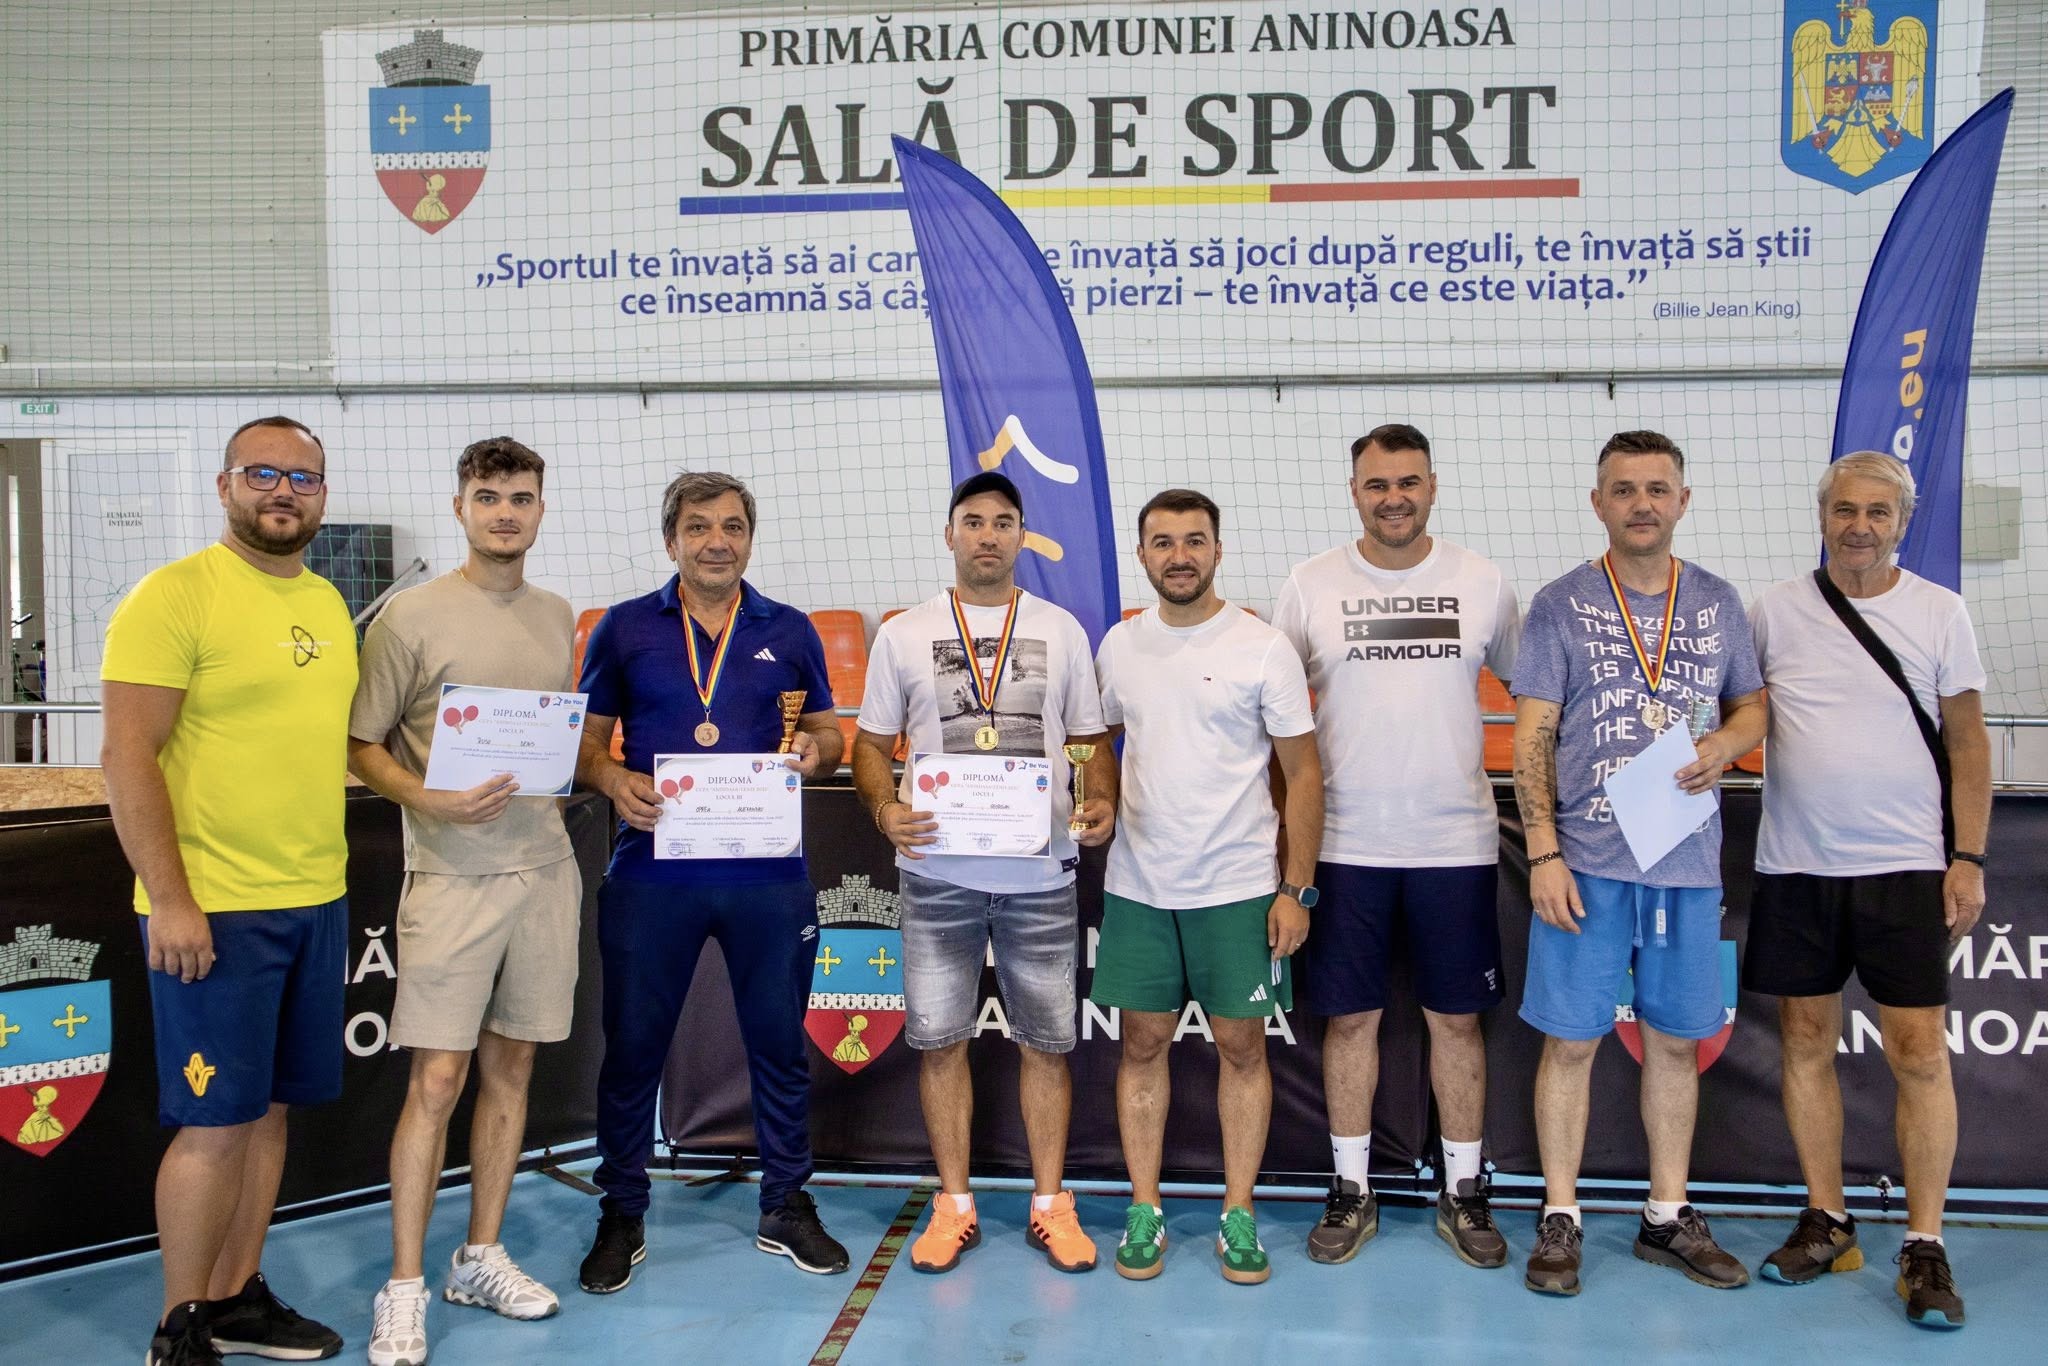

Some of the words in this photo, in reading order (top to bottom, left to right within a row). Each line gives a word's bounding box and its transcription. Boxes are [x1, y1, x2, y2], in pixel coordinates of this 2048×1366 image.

[740, 16, 987, 67] PRIMĂRIA
[1002, 16, 1235, 58] COMUNEI
[1250, 7, 1516, 52] ANINOASA
[701, 77, 962, 188] SALĂ
[1003, 96, 1147, 182] DE
[1183, 86, 1556, 177] SPORT
[628, 252, 661, 279] te
[670, 246, 773, 284] învață
[784, 245, 818, 275] să
[828, 244, 856, 274] ai
[1044, 248, 1060, 269] e
[1070, 239, 1178, 276] învață
[1189, 237, 1225, 268] să
[1235, 236, 1297, 275] joci
[1308, 235, 1397, 274] după
[1408, 232, 1523, 274] reguli,
[1535, 235, 1571, 262] te
[1580, 229, 1695, 270] învață
[1706, 227, 1744, 259] să
[1756, 226, 1811, 268] știi
[620, 294, 657, 315] ce
[665, 283, 827, 315] înseamnă
[838, 281, 872, 312] să
[1059, 277, 1076, 307] ă
[1086, 277, 1183, 316] pierzi
[1224, 278, 1261, 305] te
[1269, 271, 1380, 313] învață
[1389, 282, 1430, 304] ce
[1440, 278, 1516, 304] este
[1653, 302, 1700, 321] (Billie
[1706, 301, 1749, 318] Jean
[1755, 300, 1801, 320] King)
[26, 403, 50, 414] EXIT
[1341, 596, 1460, 616] UNDER
[1697, 602, 1720, 630] BY
[1578, 617, 1628, 639] THE
[1345, 643, 1462, 662] ARMOUR
[1584, 641, 1633, 659] THE
[1589, 660, 1620, 686] IS
[493, 708, 537, 719] DIPLOMĂ
[701, 727, 713, 742] 3
[981, 730, 991, 744] 1
[1593, 717, 1638, 748] THE
[708, 776, 753, 784] DIPLOMĂ
[963, 773, 1004, 783] DIPLOMĂ
[1584, 796, 1613, 823] IS
